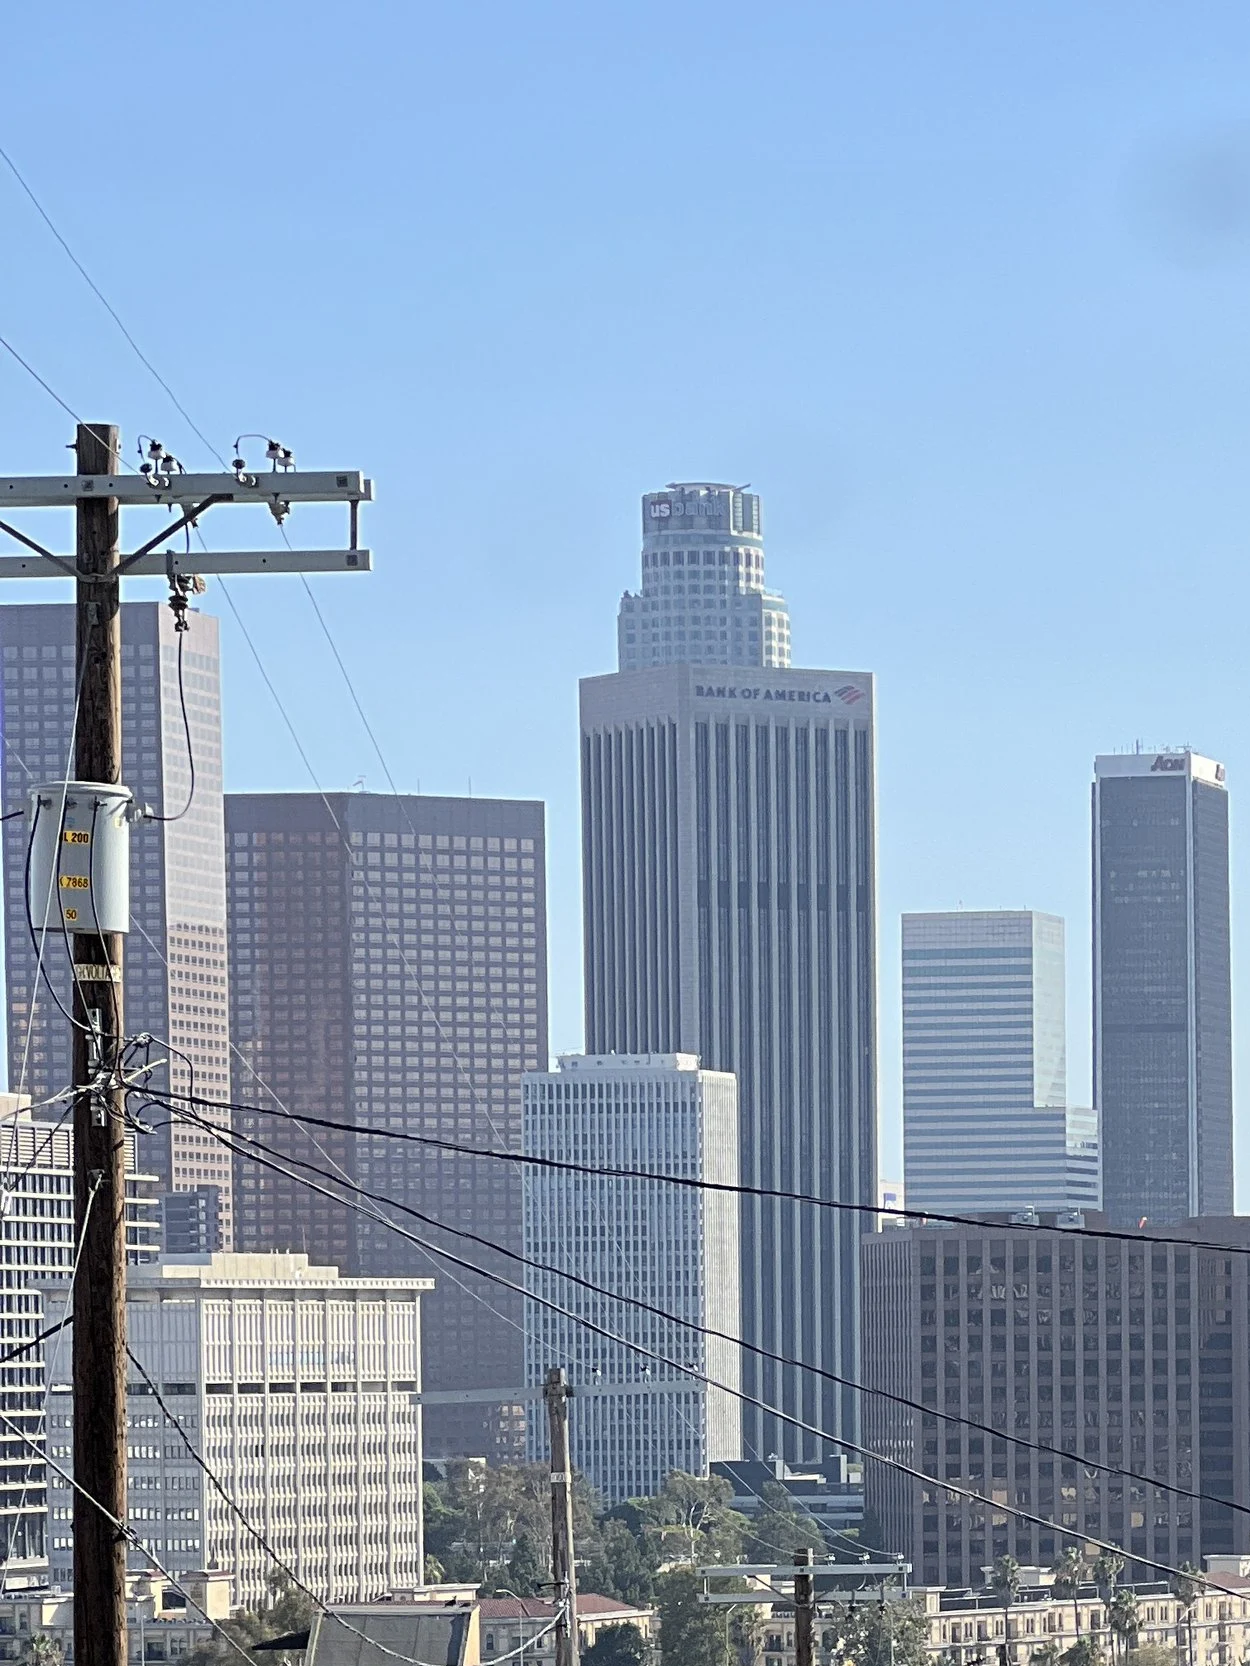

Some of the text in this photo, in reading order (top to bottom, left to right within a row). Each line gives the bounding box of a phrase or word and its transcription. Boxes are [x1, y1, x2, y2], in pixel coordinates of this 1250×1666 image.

[695, 685, 832, 703] BANK OF AMERICA
[72, 832, 89, 843] 200
[65, 909, 77, 919] 50
